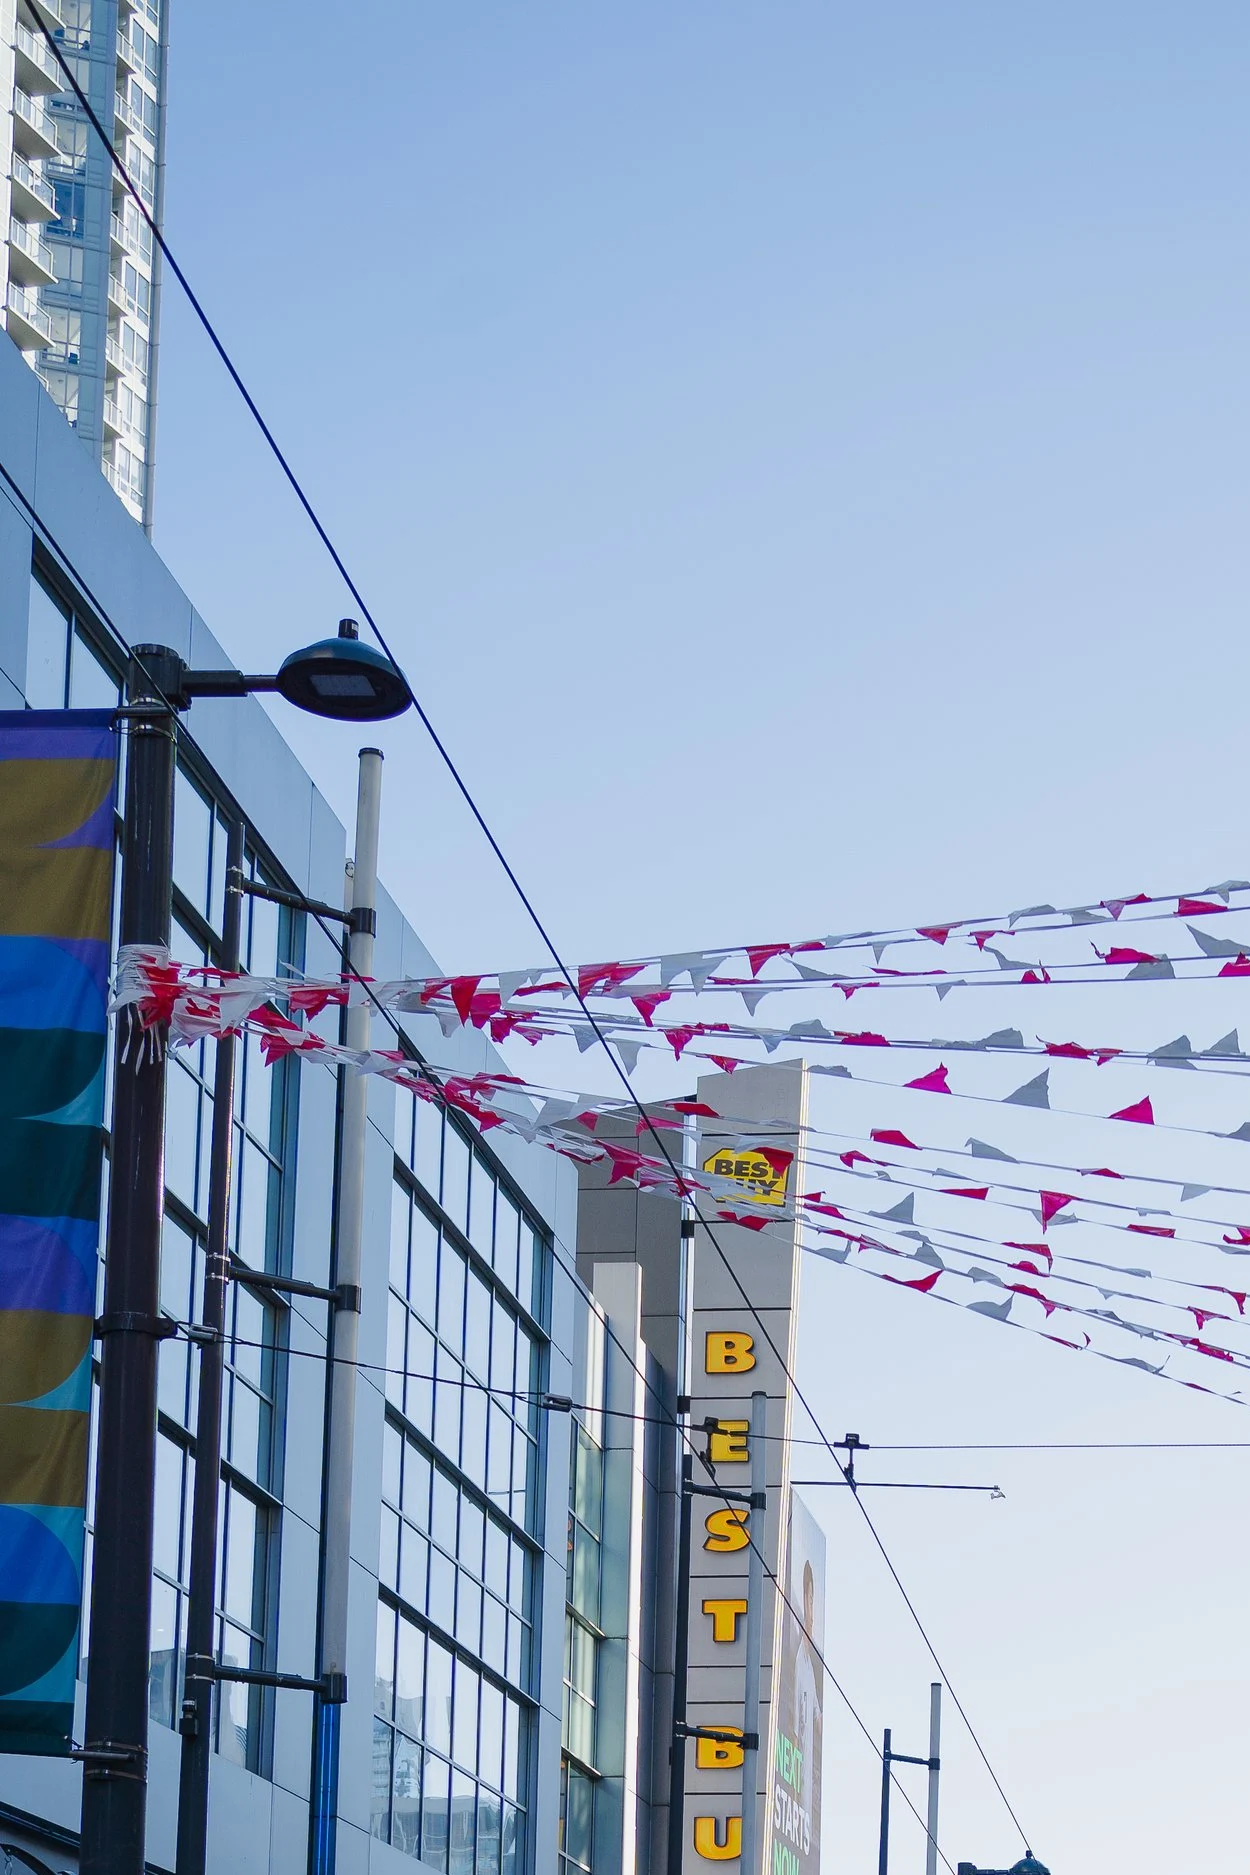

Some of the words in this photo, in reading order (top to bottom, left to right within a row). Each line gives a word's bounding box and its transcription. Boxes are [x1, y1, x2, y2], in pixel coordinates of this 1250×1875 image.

[714, 1158, 783, 1179] BES
[702, 1331, 756, 1643] BEST
[775, 1728, 804, 1794] NEXT
[774, 1783, 811, 1856] STARTS
